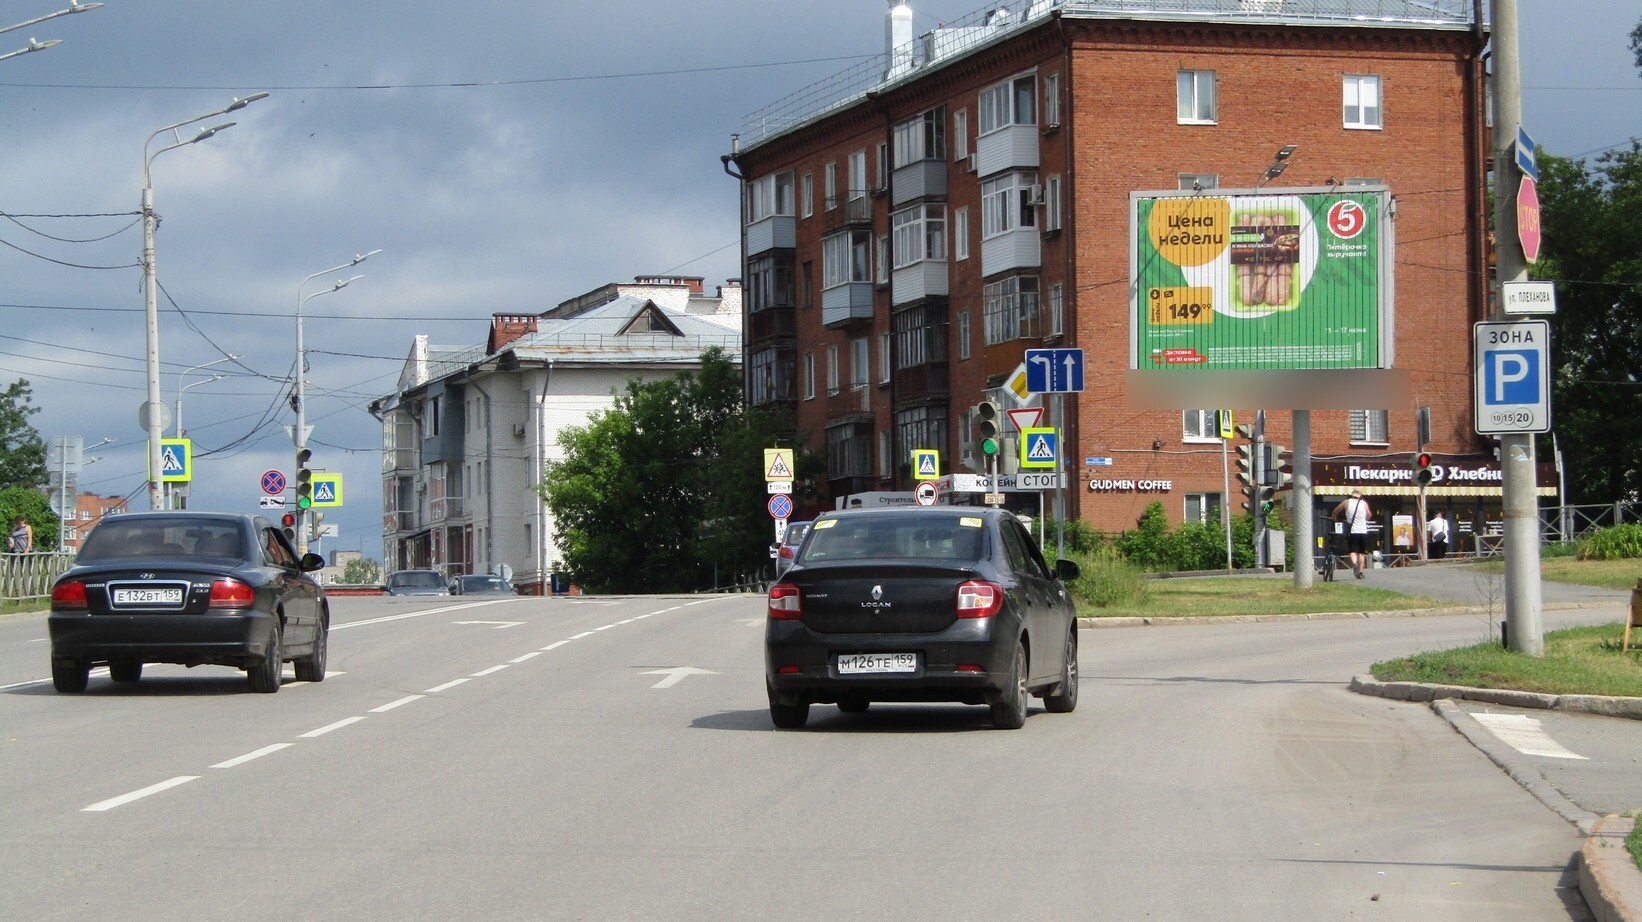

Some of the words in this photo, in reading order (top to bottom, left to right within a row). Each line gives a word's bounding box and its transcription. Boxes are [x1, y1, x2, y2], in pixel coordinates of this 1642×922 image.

[1168, 215, 1213, 229] Цена
[1336, 203, 1357, 232] 5
[1519, 204, 1538, 232] STOP
[1159, 232, 1223, 245] недели
[1509, 294, 1517, 305] ул.
[1519, 291, 1551, 302] ПЛЕХАНОВА
[1168, 303, 1202, 319] 149
[1489, 330, 1533, 344] ЗОНА
[1503, 413, 1513, 422] 15
[1516, 412, 1529, 422] 20
[1089, 479, 1135, 490] GUDMEN
[1137, 480, 1172, 490] COFFEE
[879, 496, 916, 504] Строител
[118, 590, 161, 601] Е132ВТ
[163, 590, 180, 598] 159
[840, 656, 891, 668] М126ТЕ
[894, 654, 913, 664] 159
